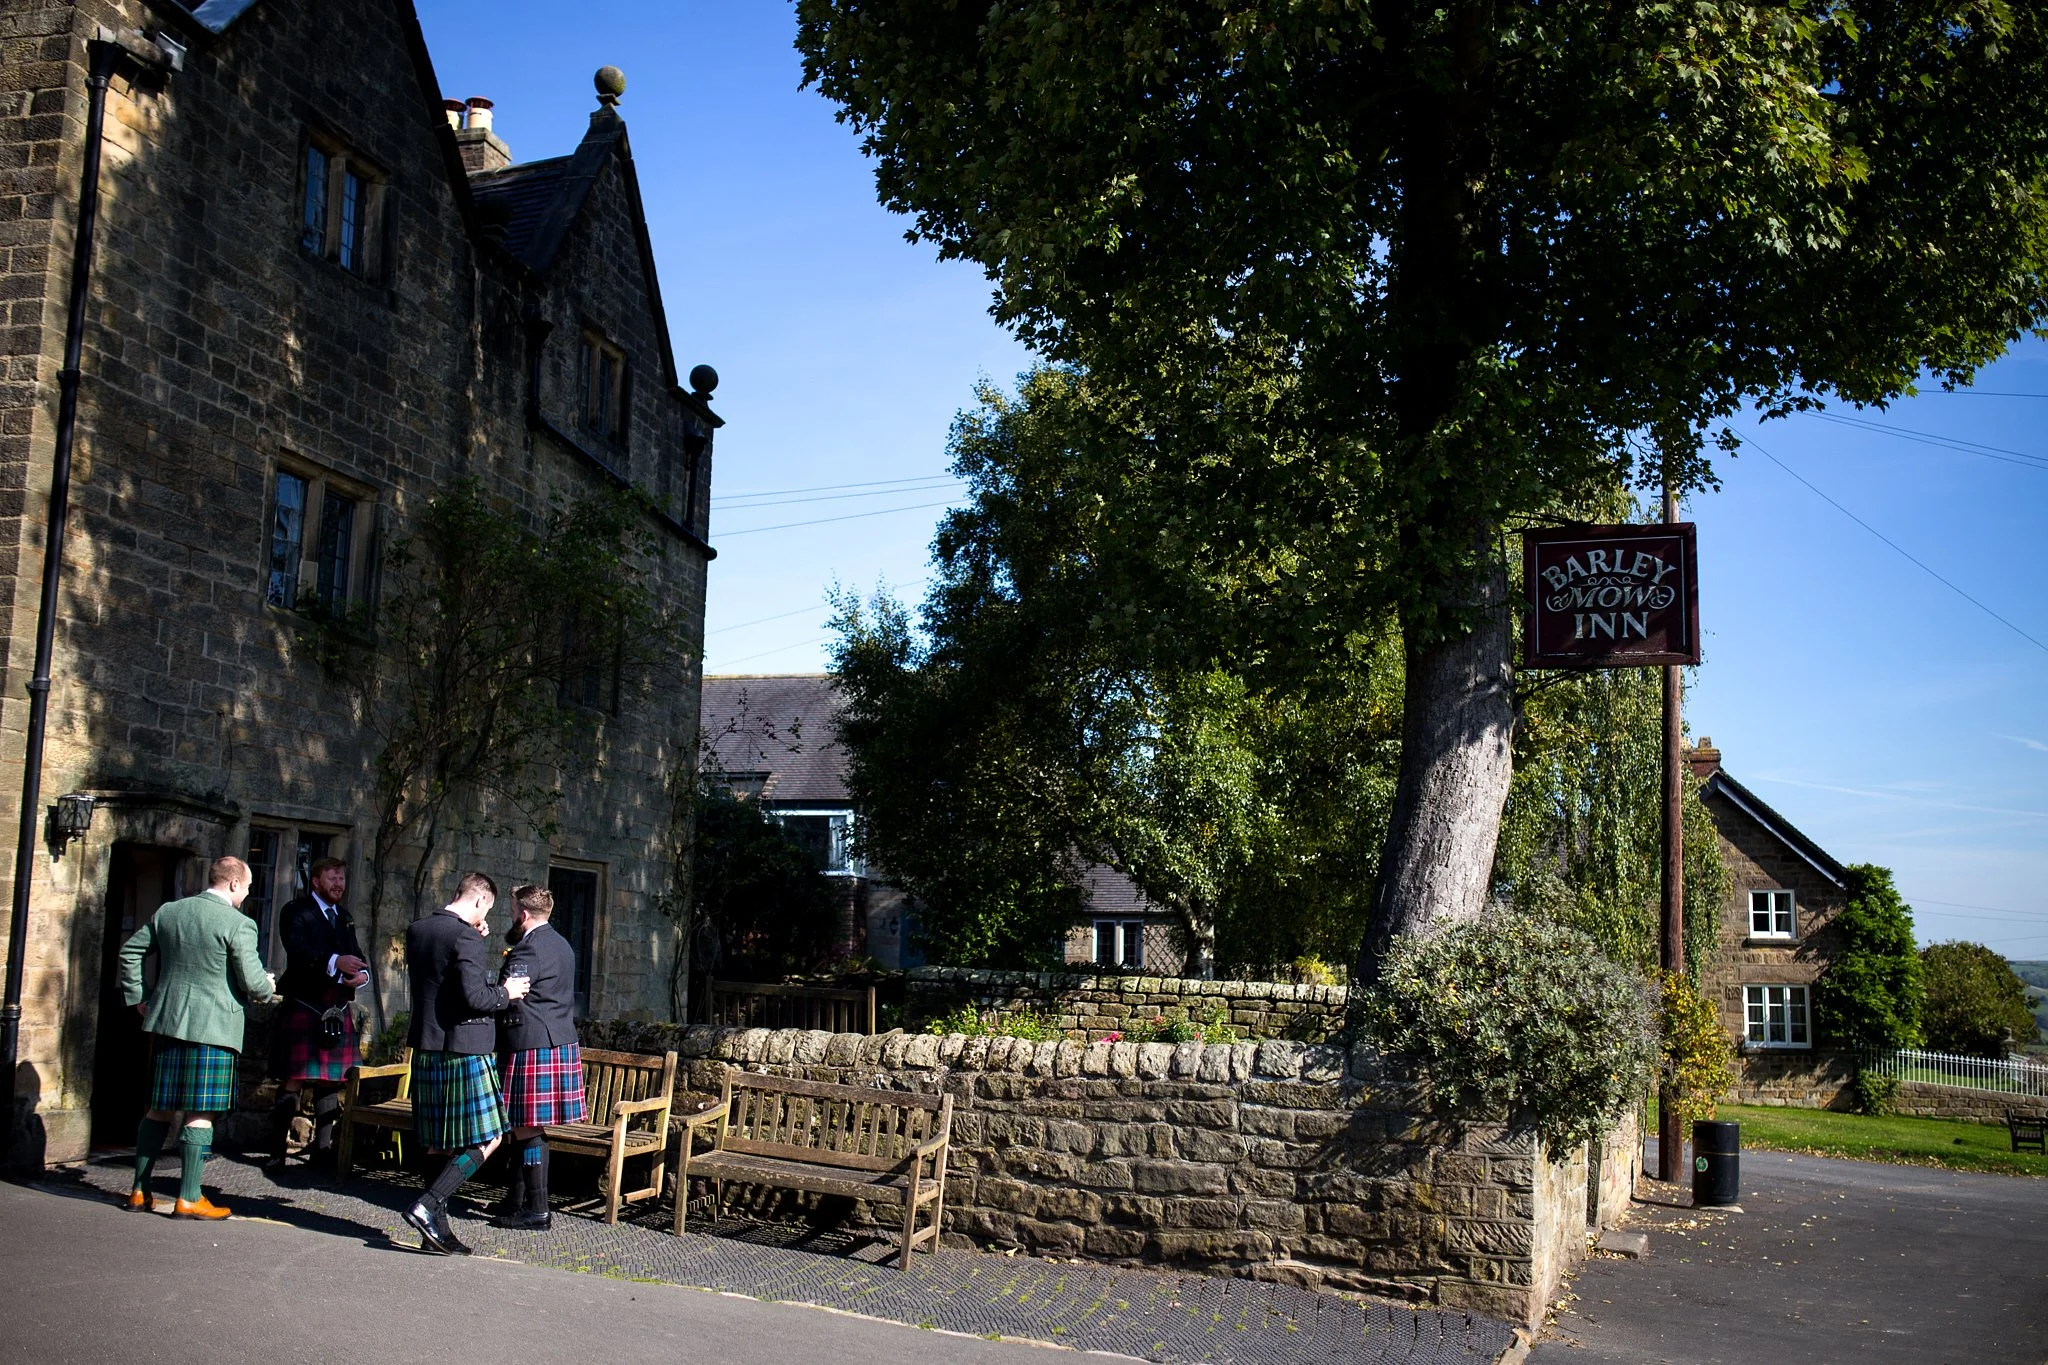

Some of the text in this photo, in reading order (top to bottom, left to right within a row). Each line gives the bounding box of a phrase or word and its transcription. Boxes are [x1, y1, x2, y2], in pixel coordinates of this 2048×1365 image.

[1542, 550, 1677, 591] BARLEY
[1548, 586, 1675, 611] MOW
[1574, 612, 1649, 639] INN
